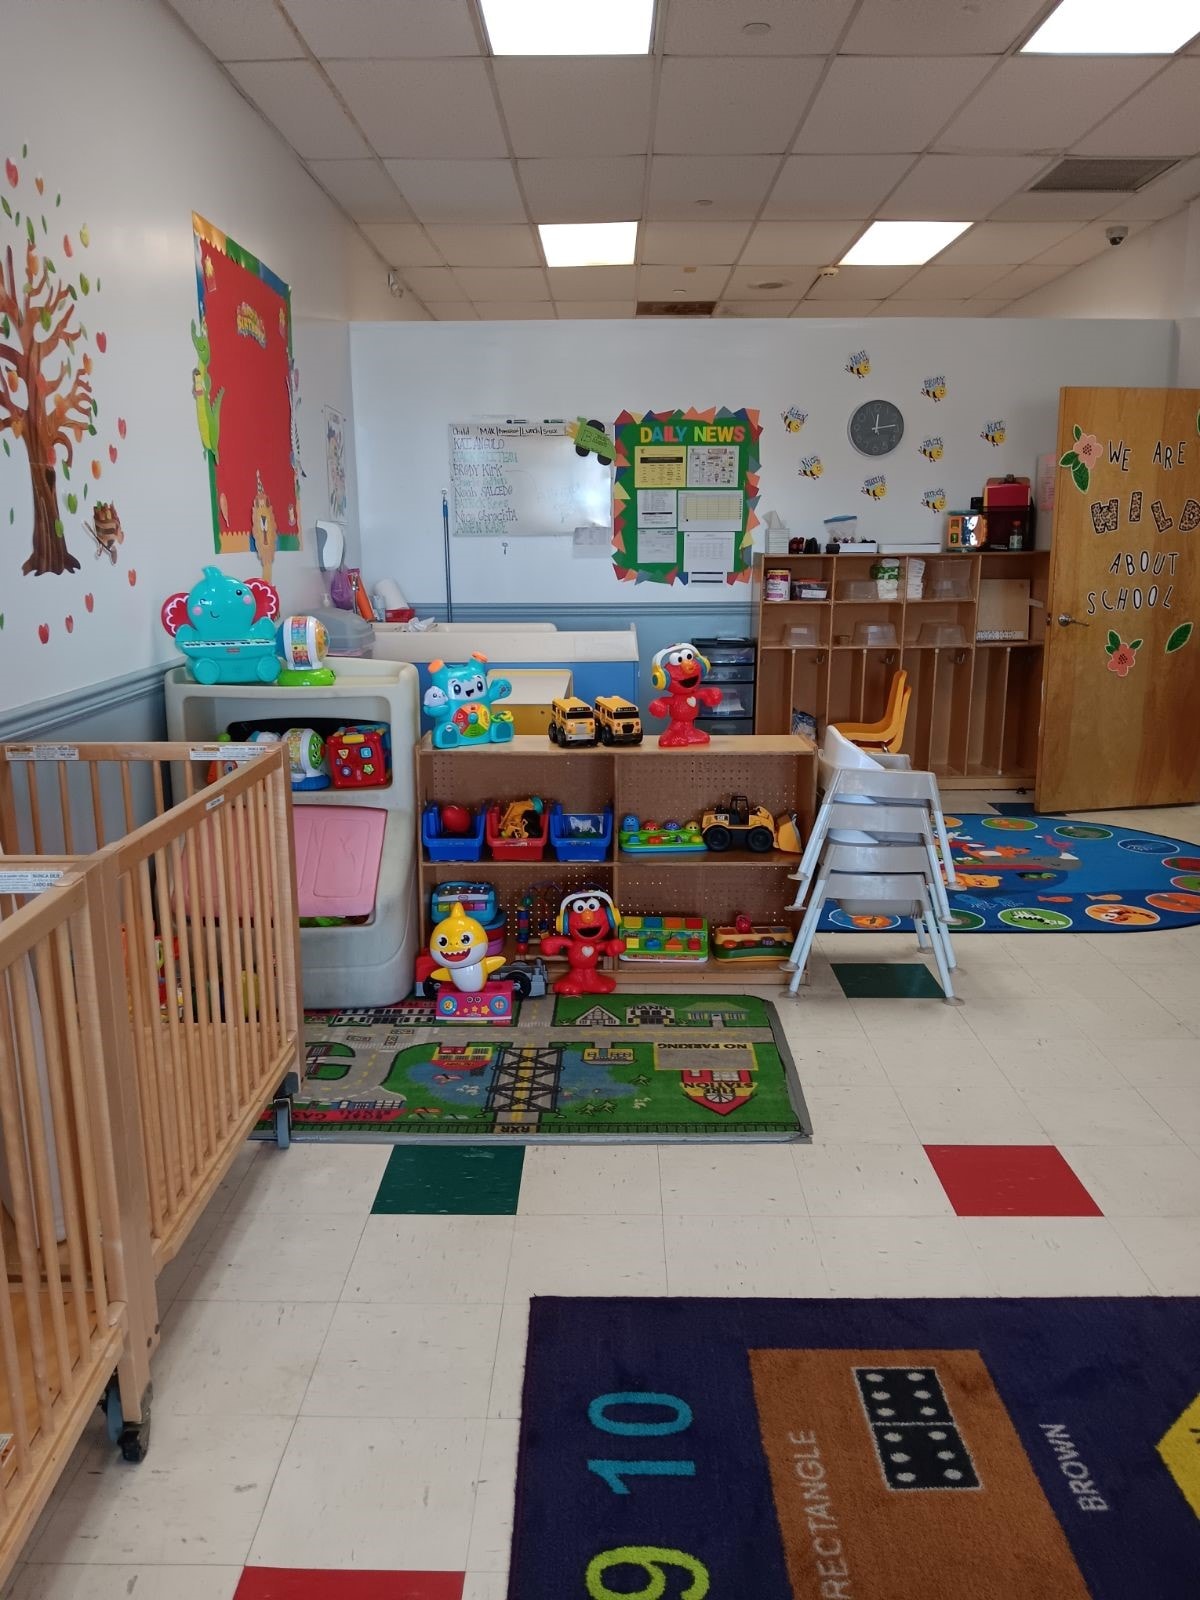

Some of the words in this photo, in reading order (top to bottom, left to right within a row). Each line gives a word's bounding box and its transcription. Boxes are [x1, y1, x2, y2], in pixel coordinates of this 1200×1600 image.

[640, 426, 687, 443] DAILY
[693, 426, 745, 442] NEWS
[1109, 440, 1131, 472] WE
[1152, 441, 1186, 470] ARE
[1091, 492, 1200, 534] WILD
[1109, 550, 1178, 576] ABOUT
[1086, 584, 1173, 615] SCHOOL
[683, 1081, 754, 1089] STATION
[587, 1391, 696, 1495] 10
[1039, 1422, 1110, 1513] BROWN
[786, 1429, 852, 1600] RECTANGLE
[585, 1546, 710, 1600] 9
